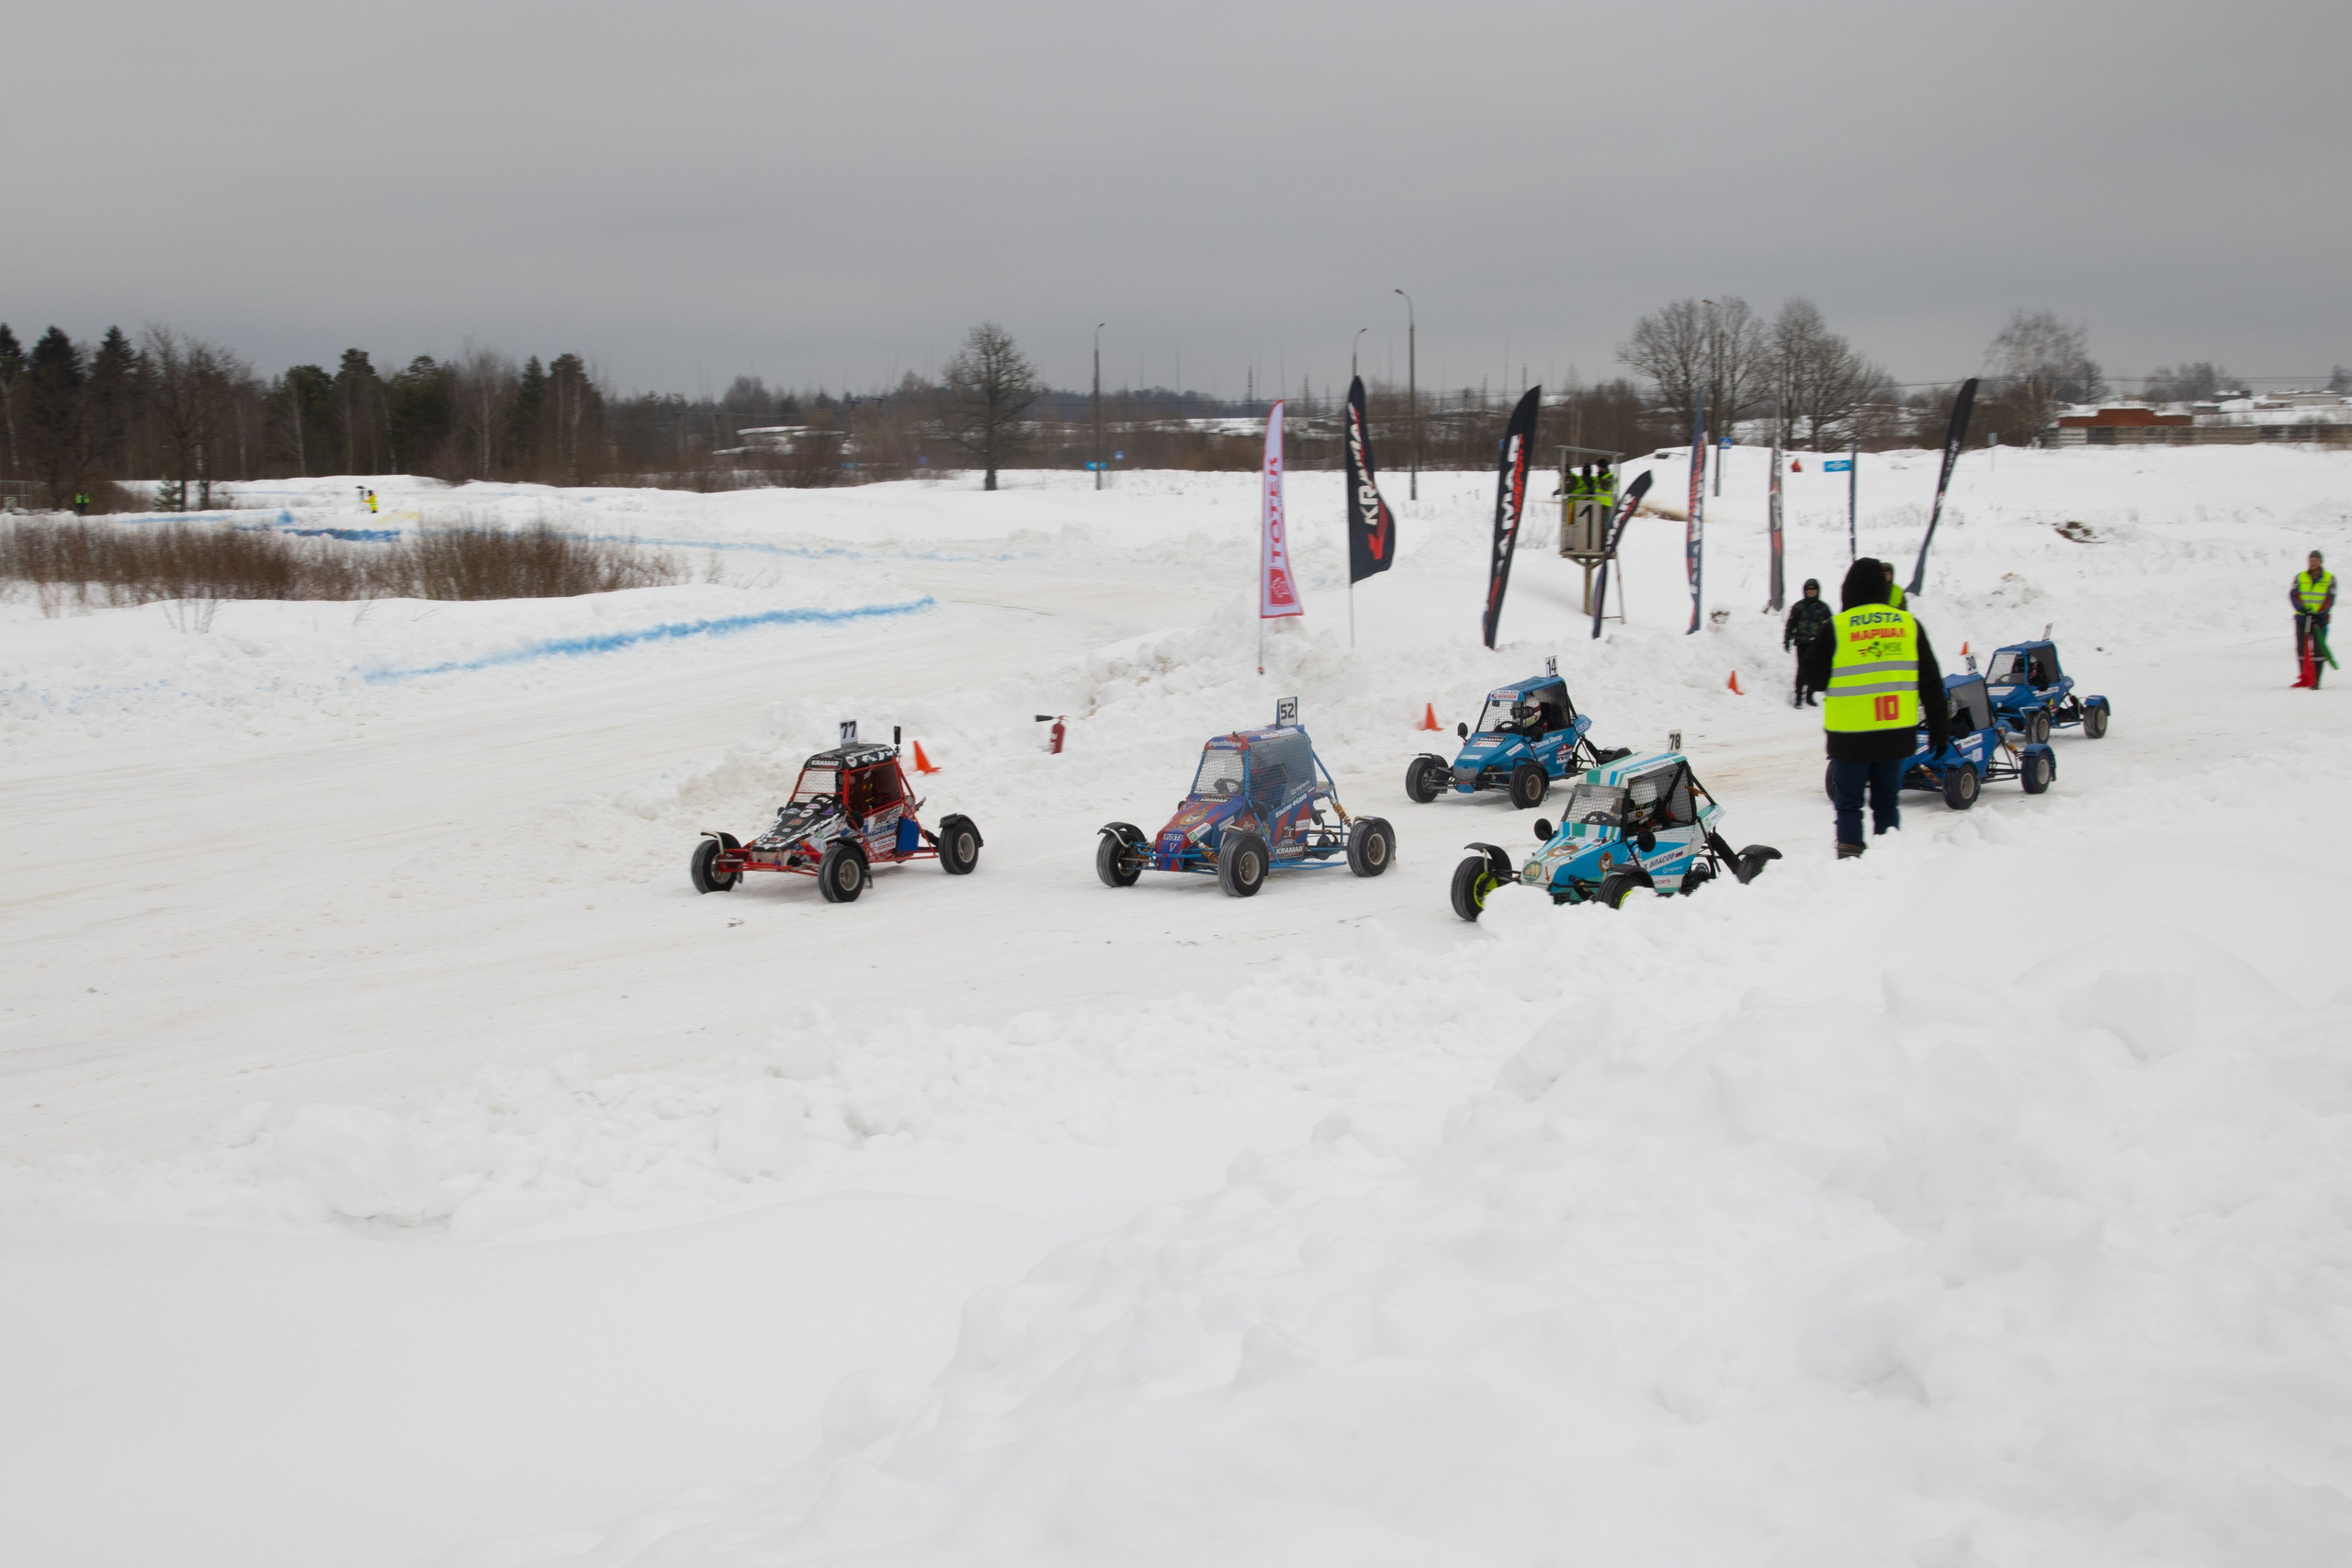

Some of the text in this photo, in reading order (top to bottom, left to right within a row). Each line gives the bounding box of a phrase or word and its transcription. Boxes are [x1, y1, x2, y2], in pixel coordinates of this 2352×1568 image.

[1577, 504, 1593, 549] 1
[1849, 612, 1904, 626] RUSTA
[1546, 658, 1556, 674] 14
[1965, 656, 1977, 671] 30
[1281, 703, 1295, 719] 52
[1874, 695, 1899, 721] 10
[840, 721, 857, 739] 77
[1669, 733, 1681, 750] 78
[1276, 846, 1304, 854] KRAMAR
[1650, 852, 1675, 868] ВЛАСОВ
